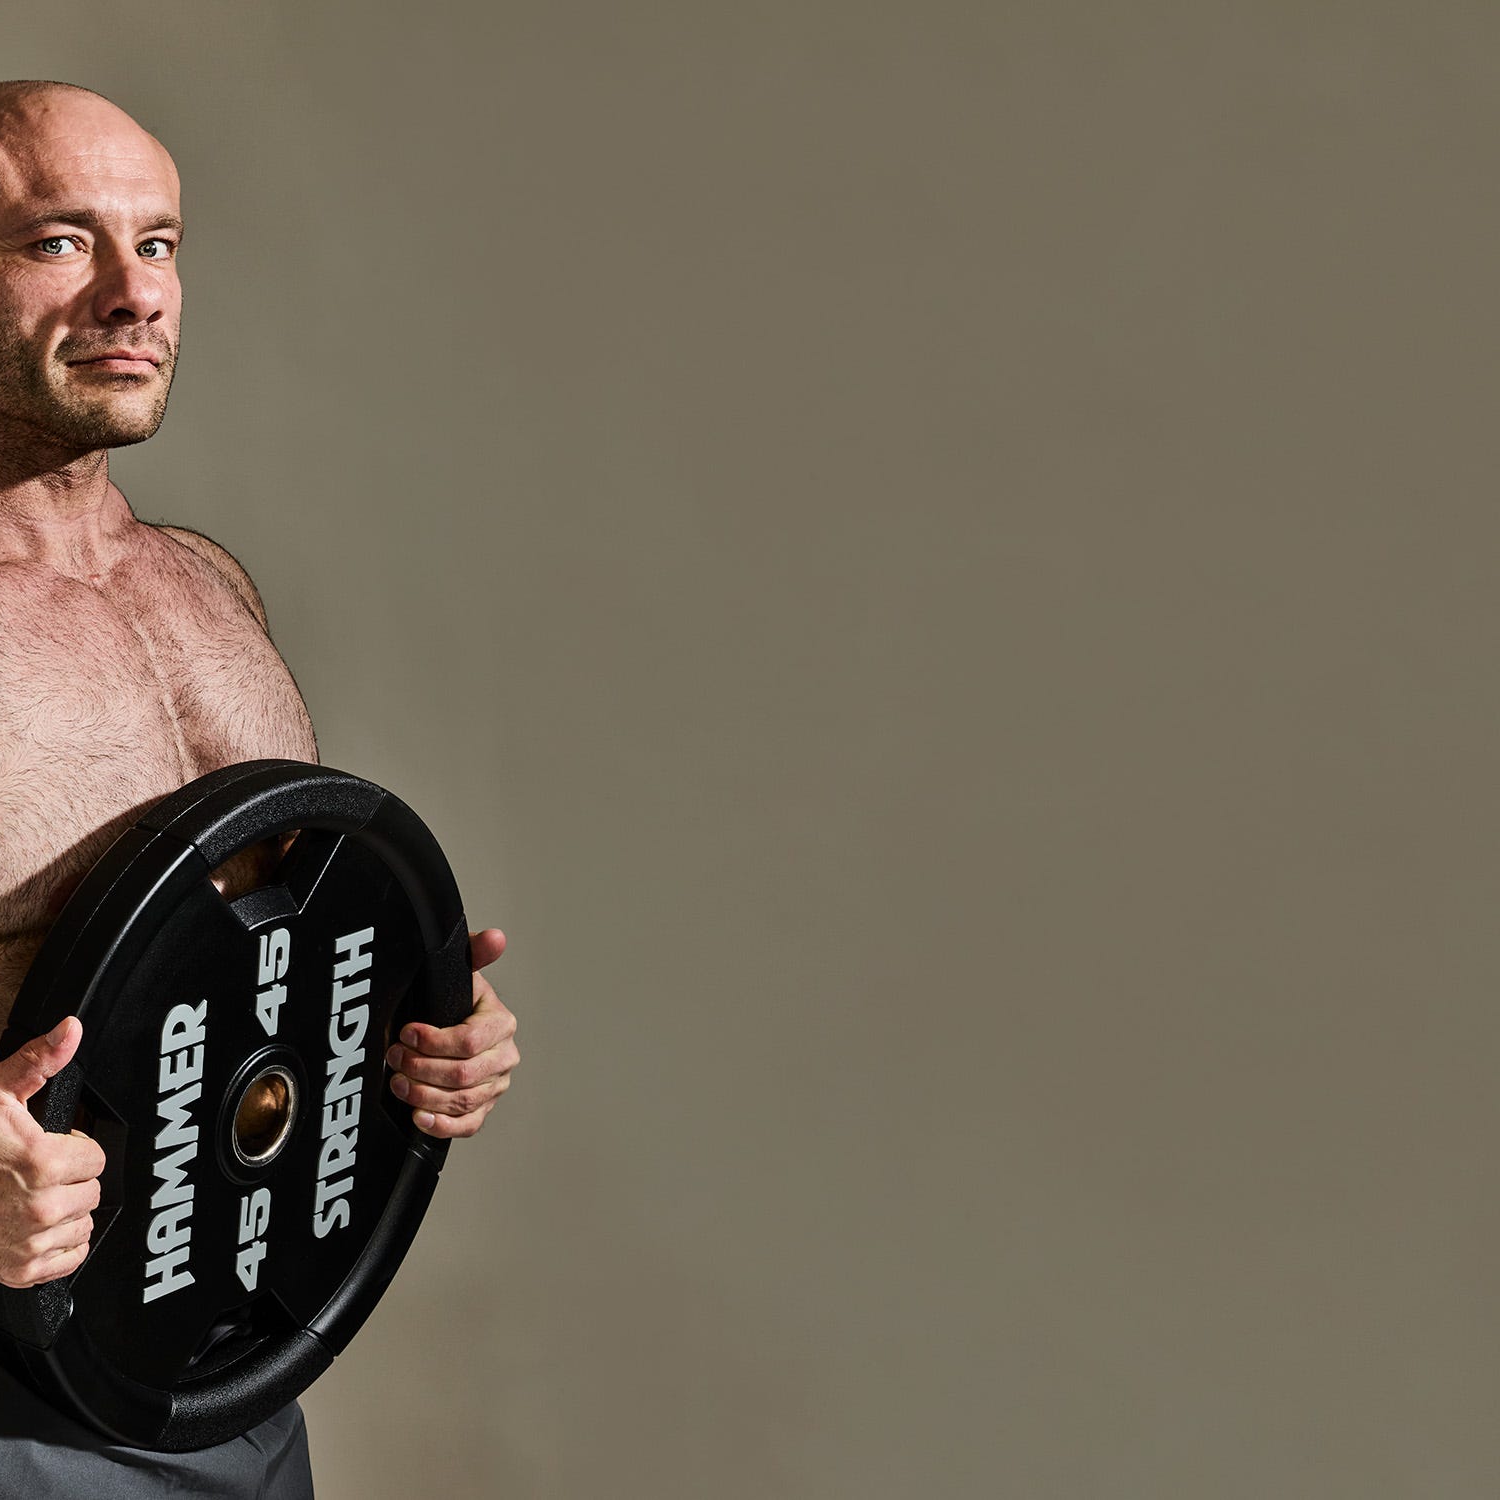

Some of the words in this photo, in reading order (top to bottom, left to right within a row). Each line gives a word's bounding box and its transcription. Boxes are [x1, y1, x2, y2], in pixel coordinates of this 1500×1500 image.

[255, 927, 291, 1037] 45
[312, 926, 375, 1239] STRENGTH
[143, 998, 208, 1303] HAMMER
[236, 1187, 271, 1292] 45
